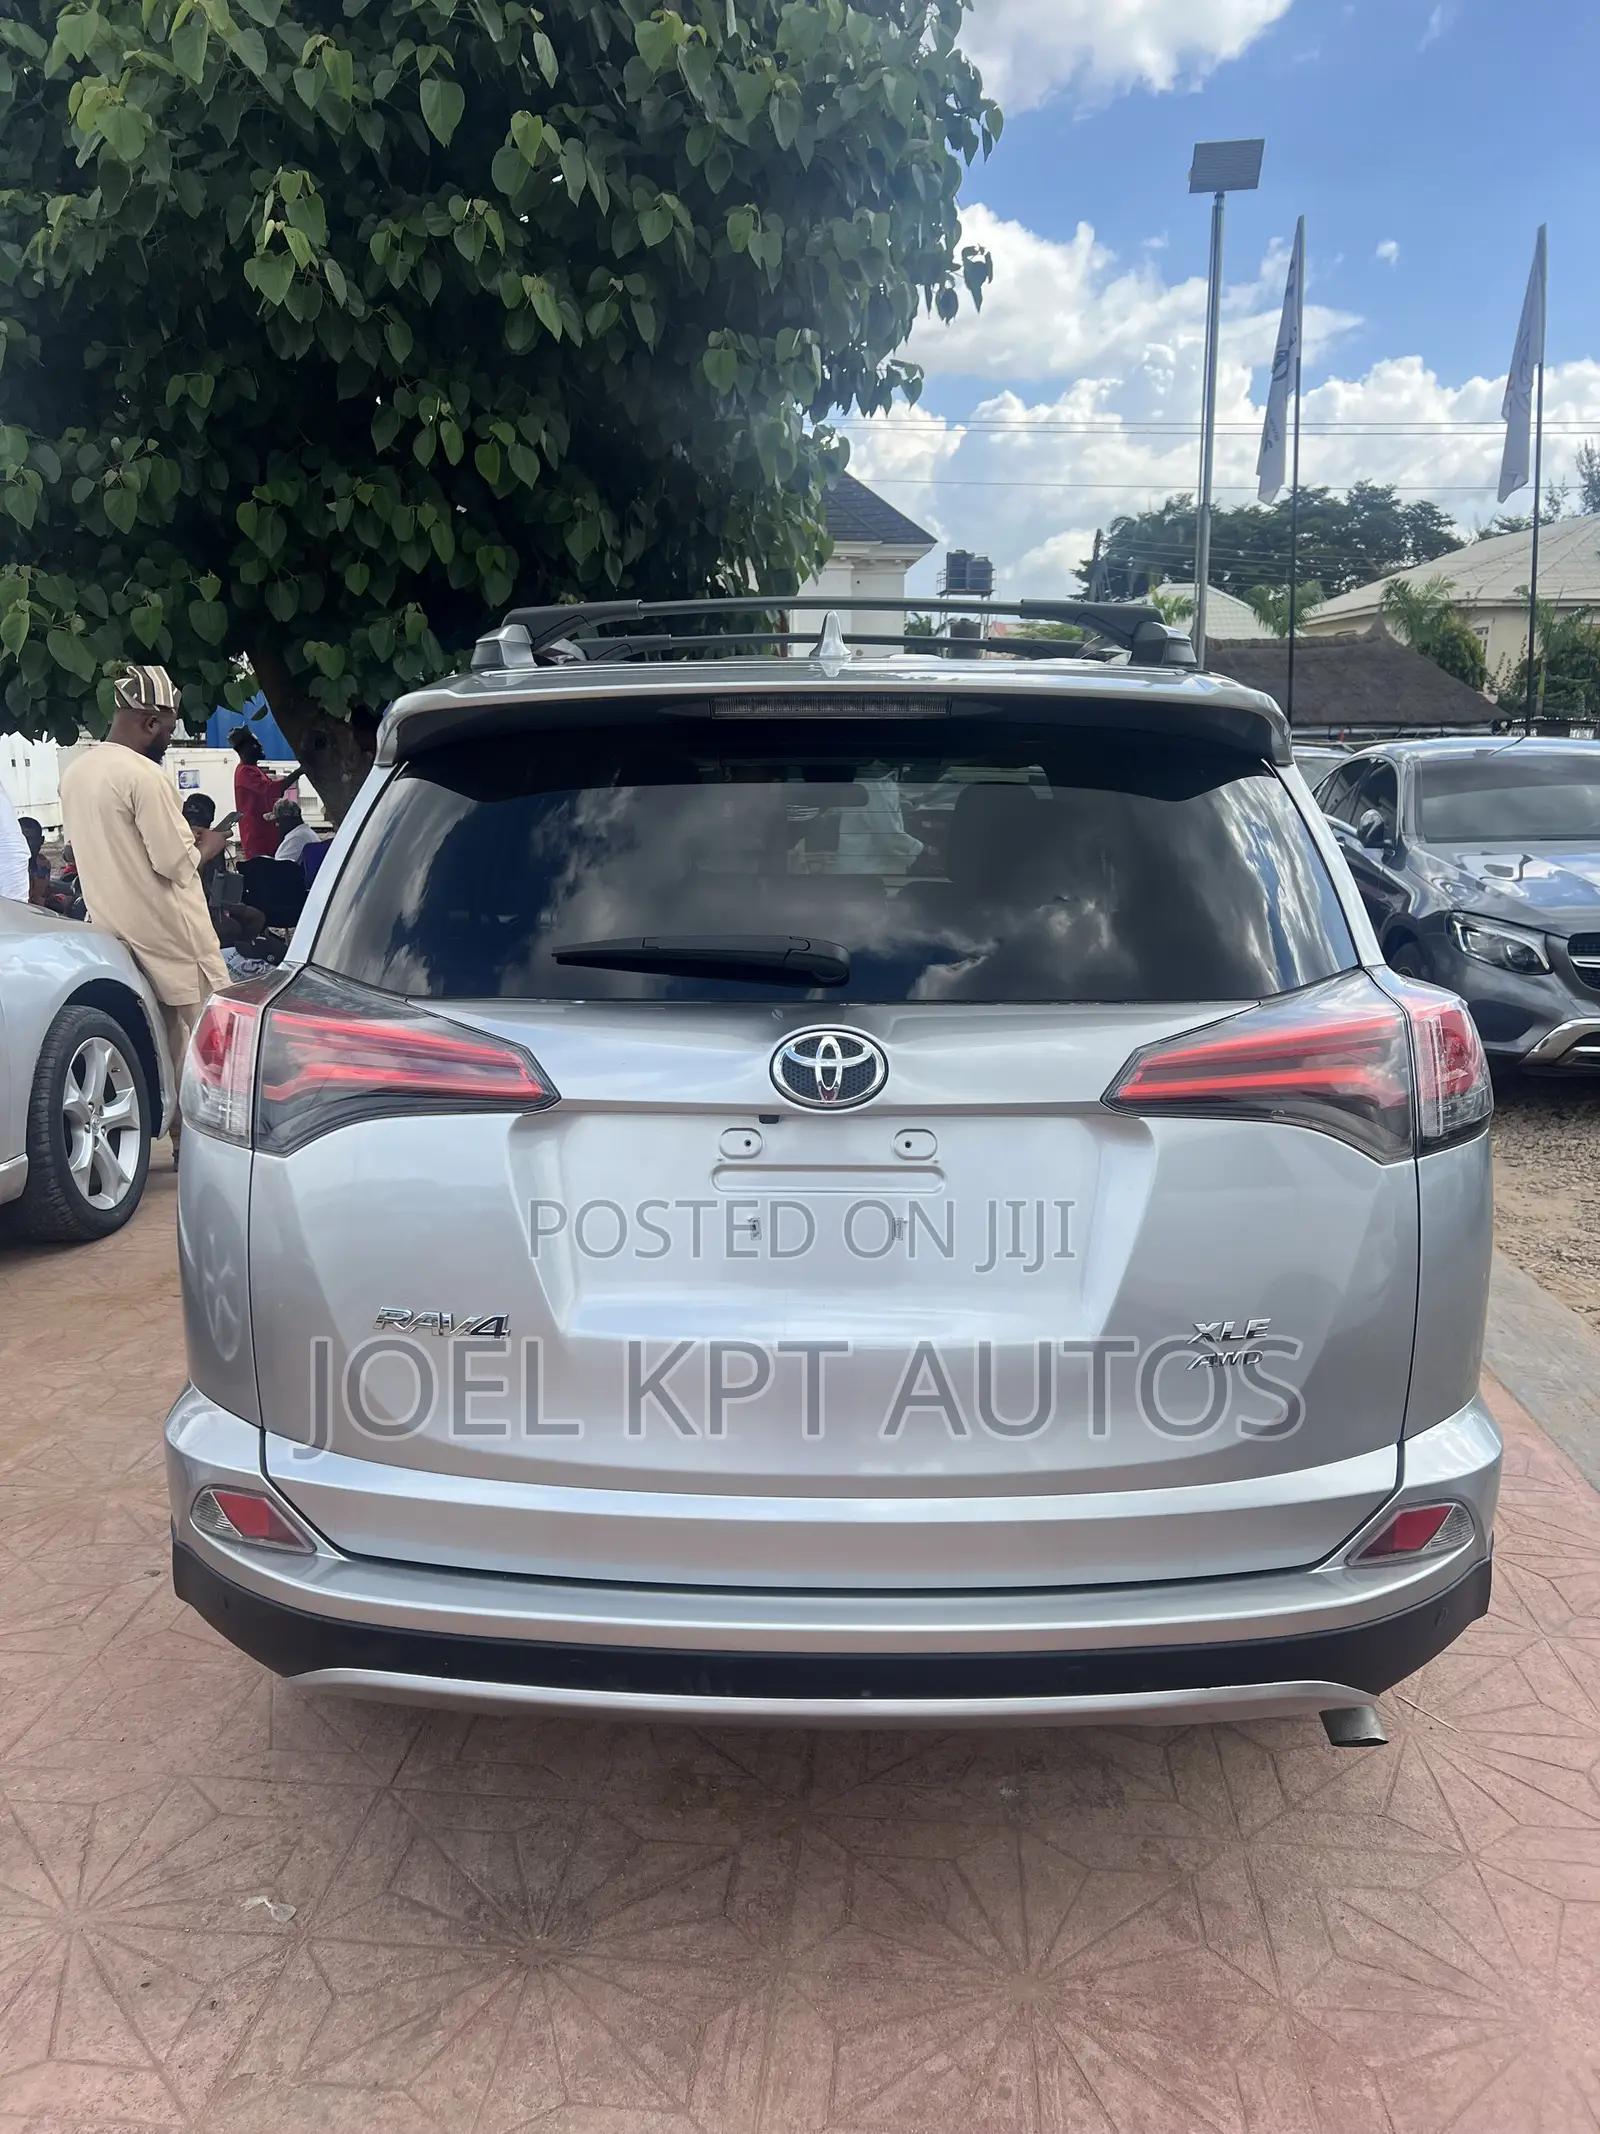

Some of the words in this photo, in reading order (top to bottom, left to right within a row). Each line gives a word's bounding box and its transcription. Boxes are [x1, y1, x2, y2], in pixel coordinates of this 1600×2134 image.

[373, 1306, 511, 1340] RAV4
[1186, 1317, 1272, 1345] XLE
[1186, 1349, 1264, 1372] AWD
